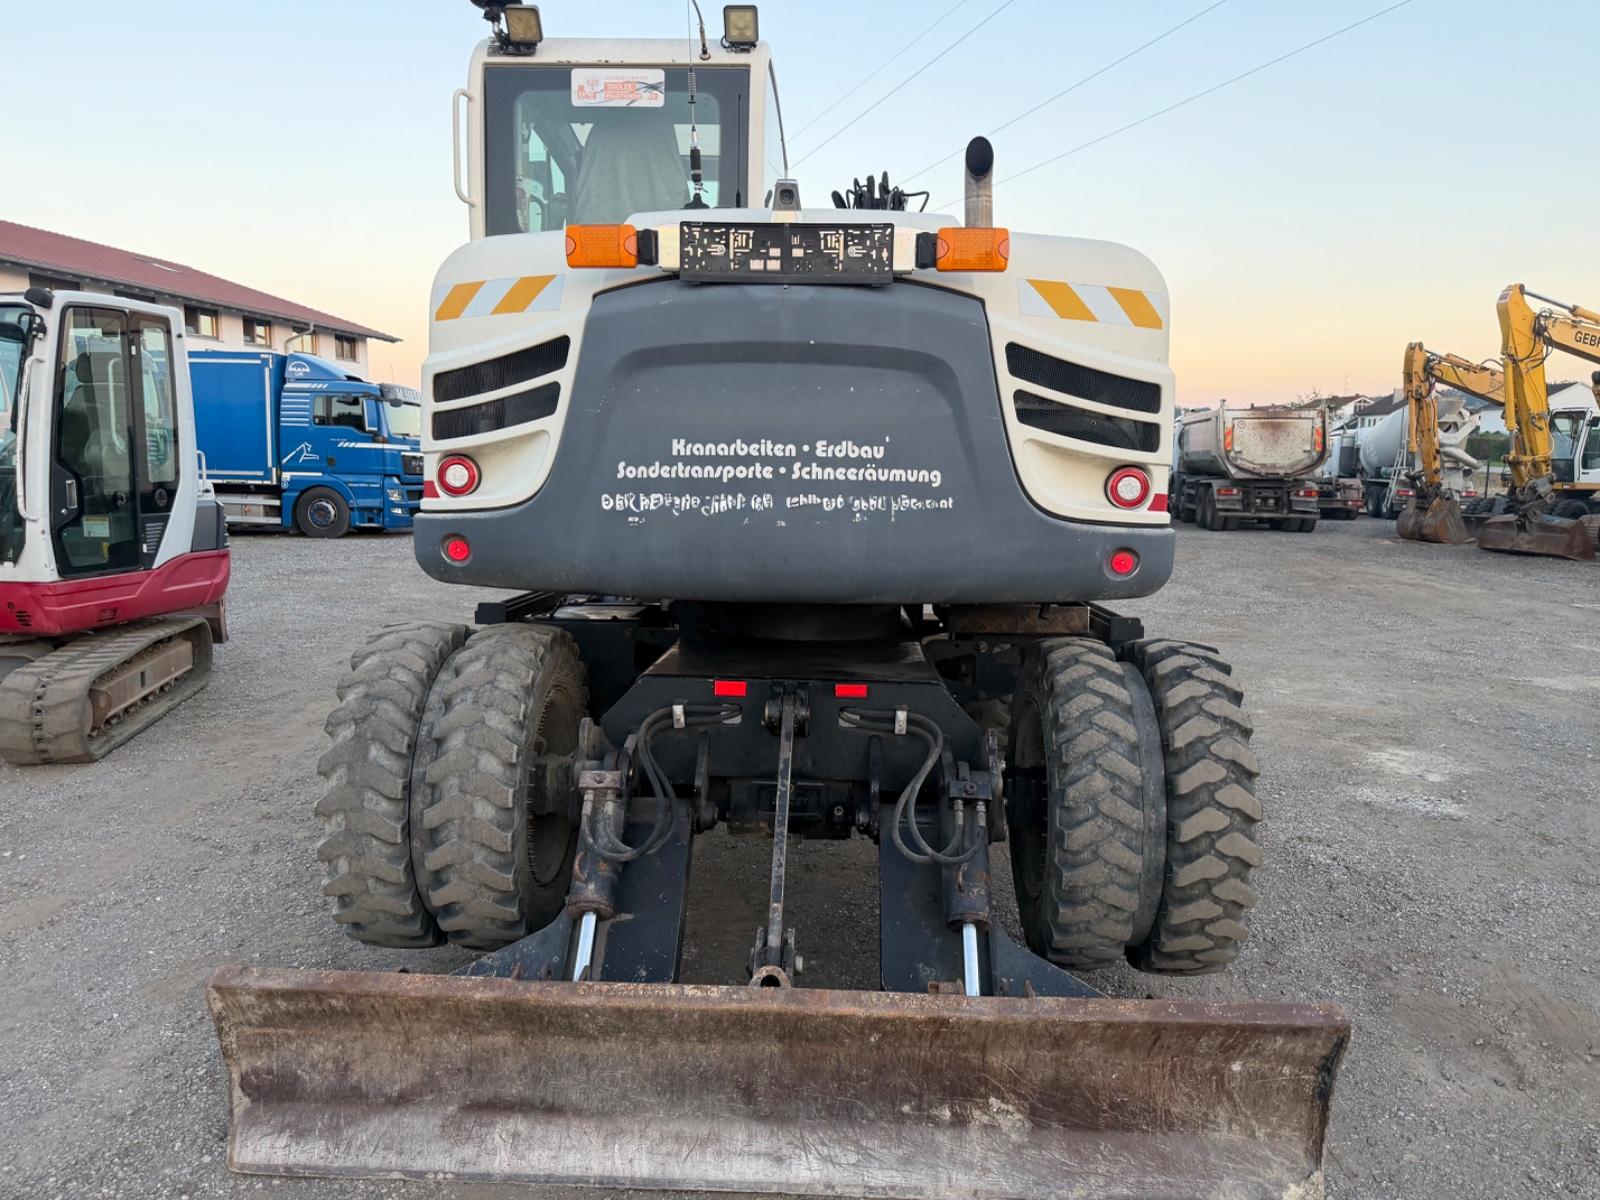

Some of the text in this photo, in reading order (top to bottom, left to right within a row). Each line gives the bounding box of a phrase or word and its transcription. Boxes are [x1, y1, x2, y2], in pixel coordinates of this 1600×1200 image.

[671, 438, 885, 459] Kranarbeiten Erdbau
[616, 461, 942, 488] Sondertransporte Schneeräumung
